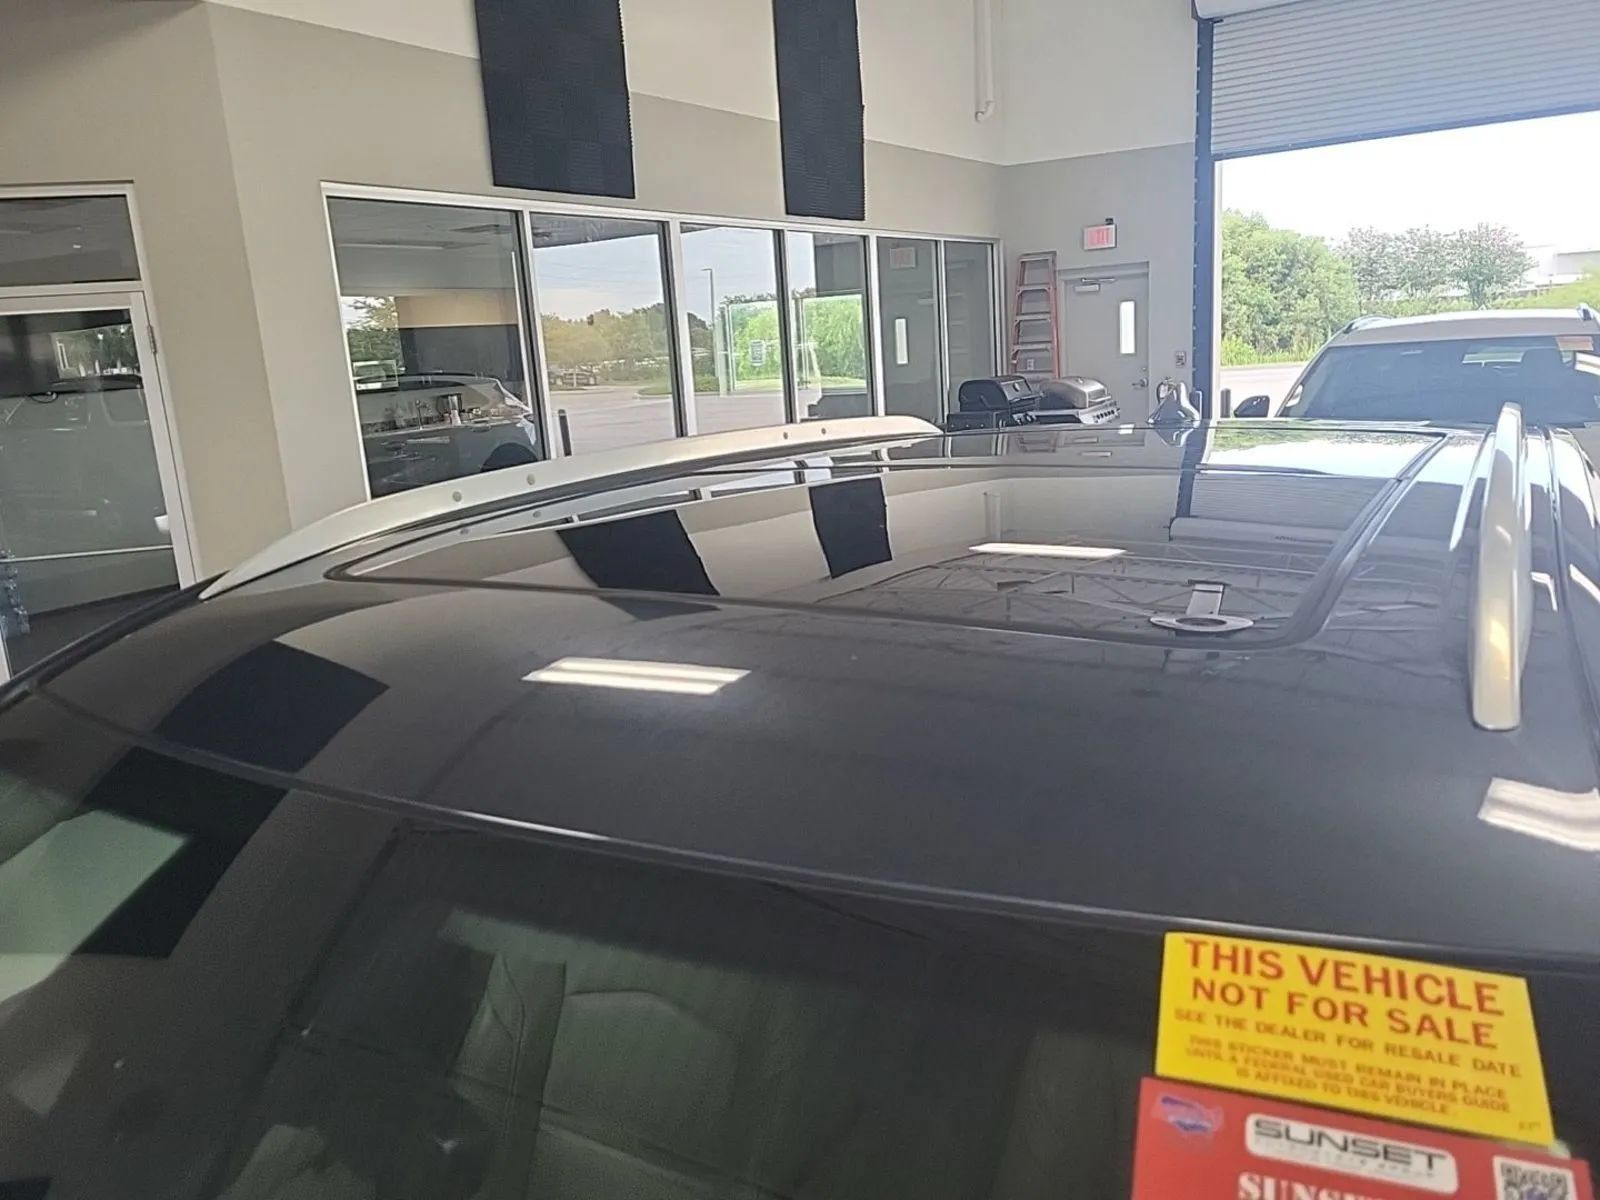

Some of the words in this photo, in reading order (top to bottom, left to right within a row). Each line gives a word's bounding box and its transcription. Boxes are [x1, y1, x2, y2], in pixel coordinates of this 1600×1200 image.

[1184, 938, 1285, 980] THIS
[1297, 954, 1504, 1016] VEHICLE
[1192, 977, 1270, 1011] NOT
[1287, 991, 1368, 1027] FOR
[1386, 1008, 1497, 1049] SALE
[1174, 1008, 1206, 1024] SEE
[1215, 1014, 1247, 1030] THE
[1256, 1022, 1325, 1042] DEALER
[1336, 1035, 1373, 1051] FOR
[1384, 1043, 1460, 1067] RESALE
[1472, 1058, 1522, 1078] DATE
[1228, 1041, 1294, 1061] STICKER
[1301, 1053, 1347, 1070] MUST
[1355, 1063, 1421, 1083] REMAIN
[1429, 1077, 1445, 1088] IN
[1452, 1080, 1507, 1099] PLACE
[1229, 1054, 1238, 1064] A
[1244, 1056, 1306, 1075] FEDERAL
[1313, 1069, 1354, 1084] USED
[1360, 1077, 1391, 1090] CAR
[1396, 1083, 1457, 1103] BUYERS
[1463, 1095, 1510, 1113] GUIDE
[1236, 1068, 1249, 1078] IS
[1255, 1071, 1317, 1089] AFFIXED
[1322, 1082, 1341, 1095] TO
[1346, 1087, 1380, 1102] THIS
[1385, 1094, 1449, 1115] VEHICLE
[1254, 1118, 1447, 1170] SUNSET
